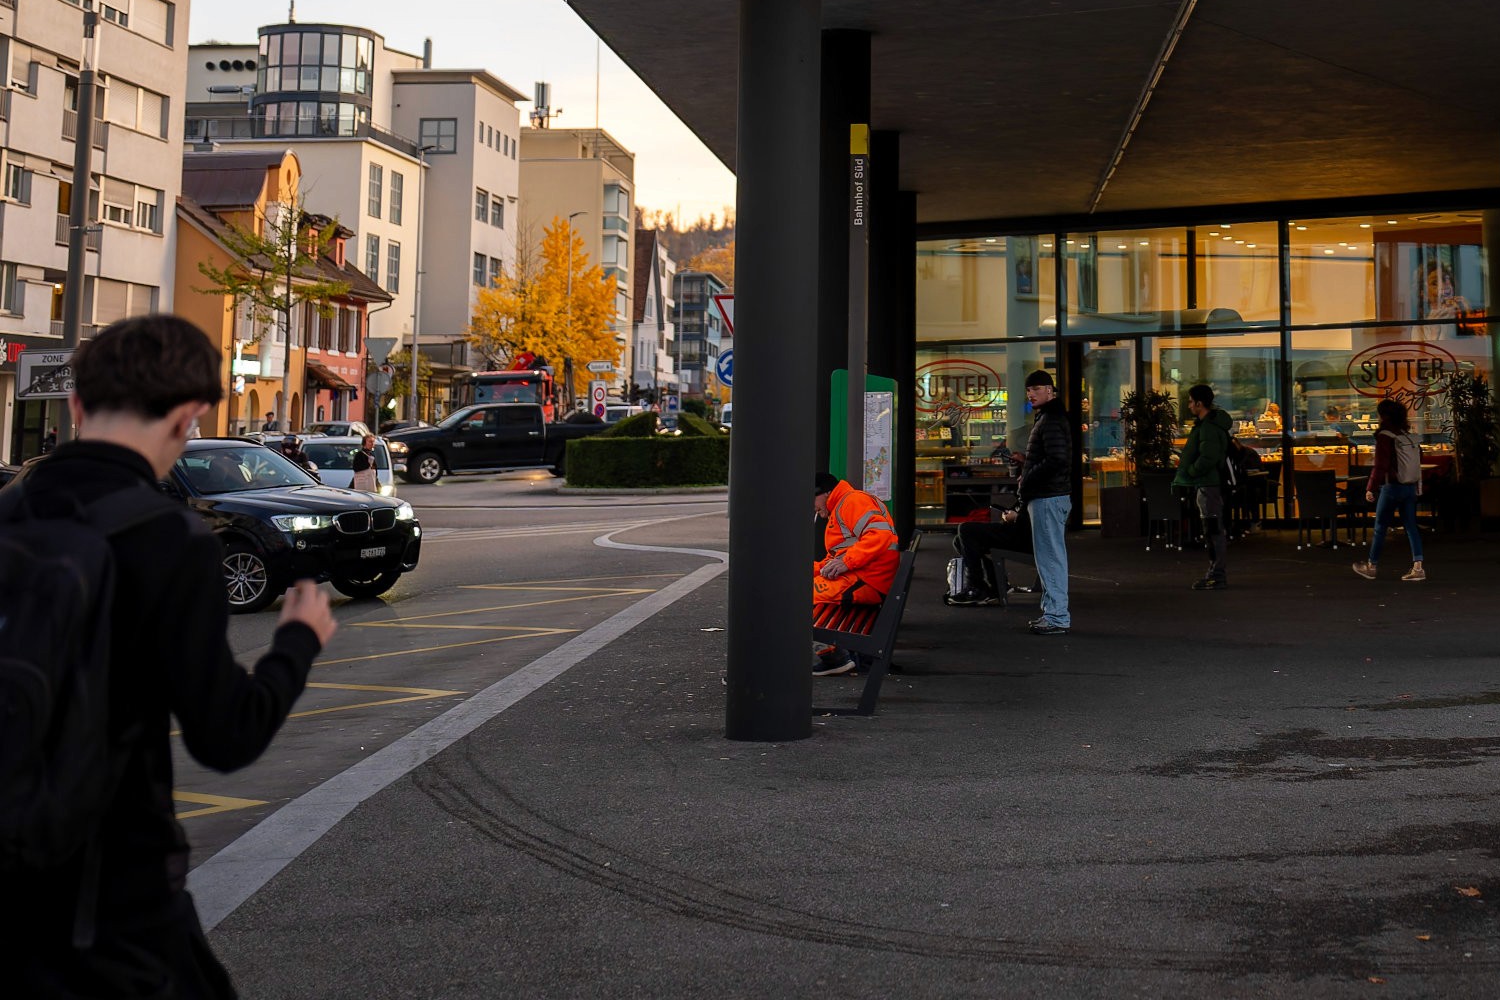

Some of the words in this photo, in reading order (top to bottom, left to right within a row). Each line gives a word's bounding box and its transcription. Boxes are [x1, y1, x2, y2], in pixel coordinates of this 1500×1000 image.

[854, 158, 864, 178] Süd
[854, 181, 863, 226] Bahnhof
[42, 355, 64, 363] ZONE
[1360, 357, 1444, 382] SUTTER
[916, 375, 989, 398] SUTTER
